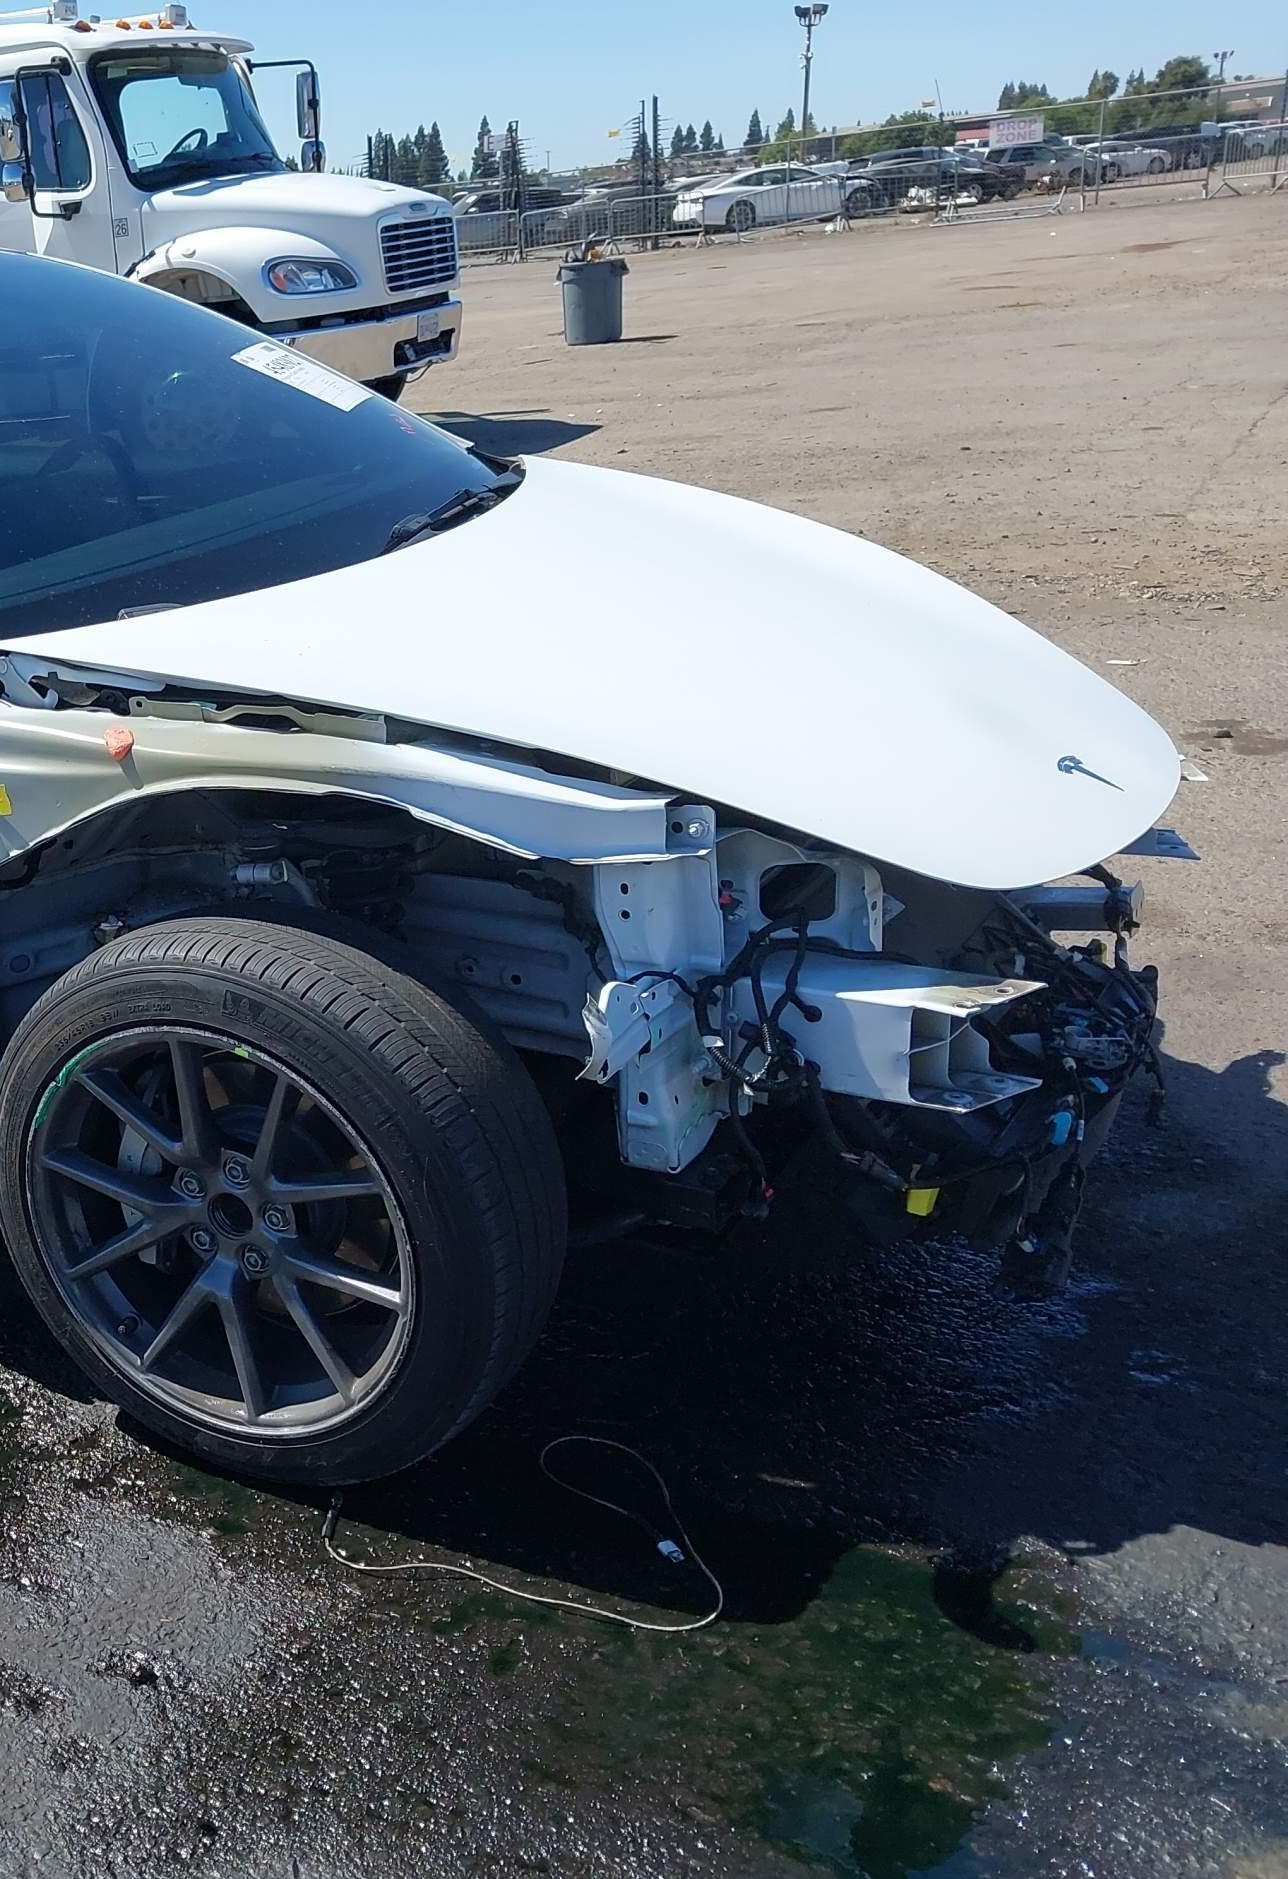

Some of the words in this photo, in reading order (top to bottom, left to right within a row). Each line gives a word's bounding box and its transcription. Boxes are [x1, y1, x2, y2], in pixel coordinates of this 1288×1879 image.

[996, 119, 1038, 133] DROP
[996, 131, 1037, 144] ZONE
[115, 224, 127, 236] 26
